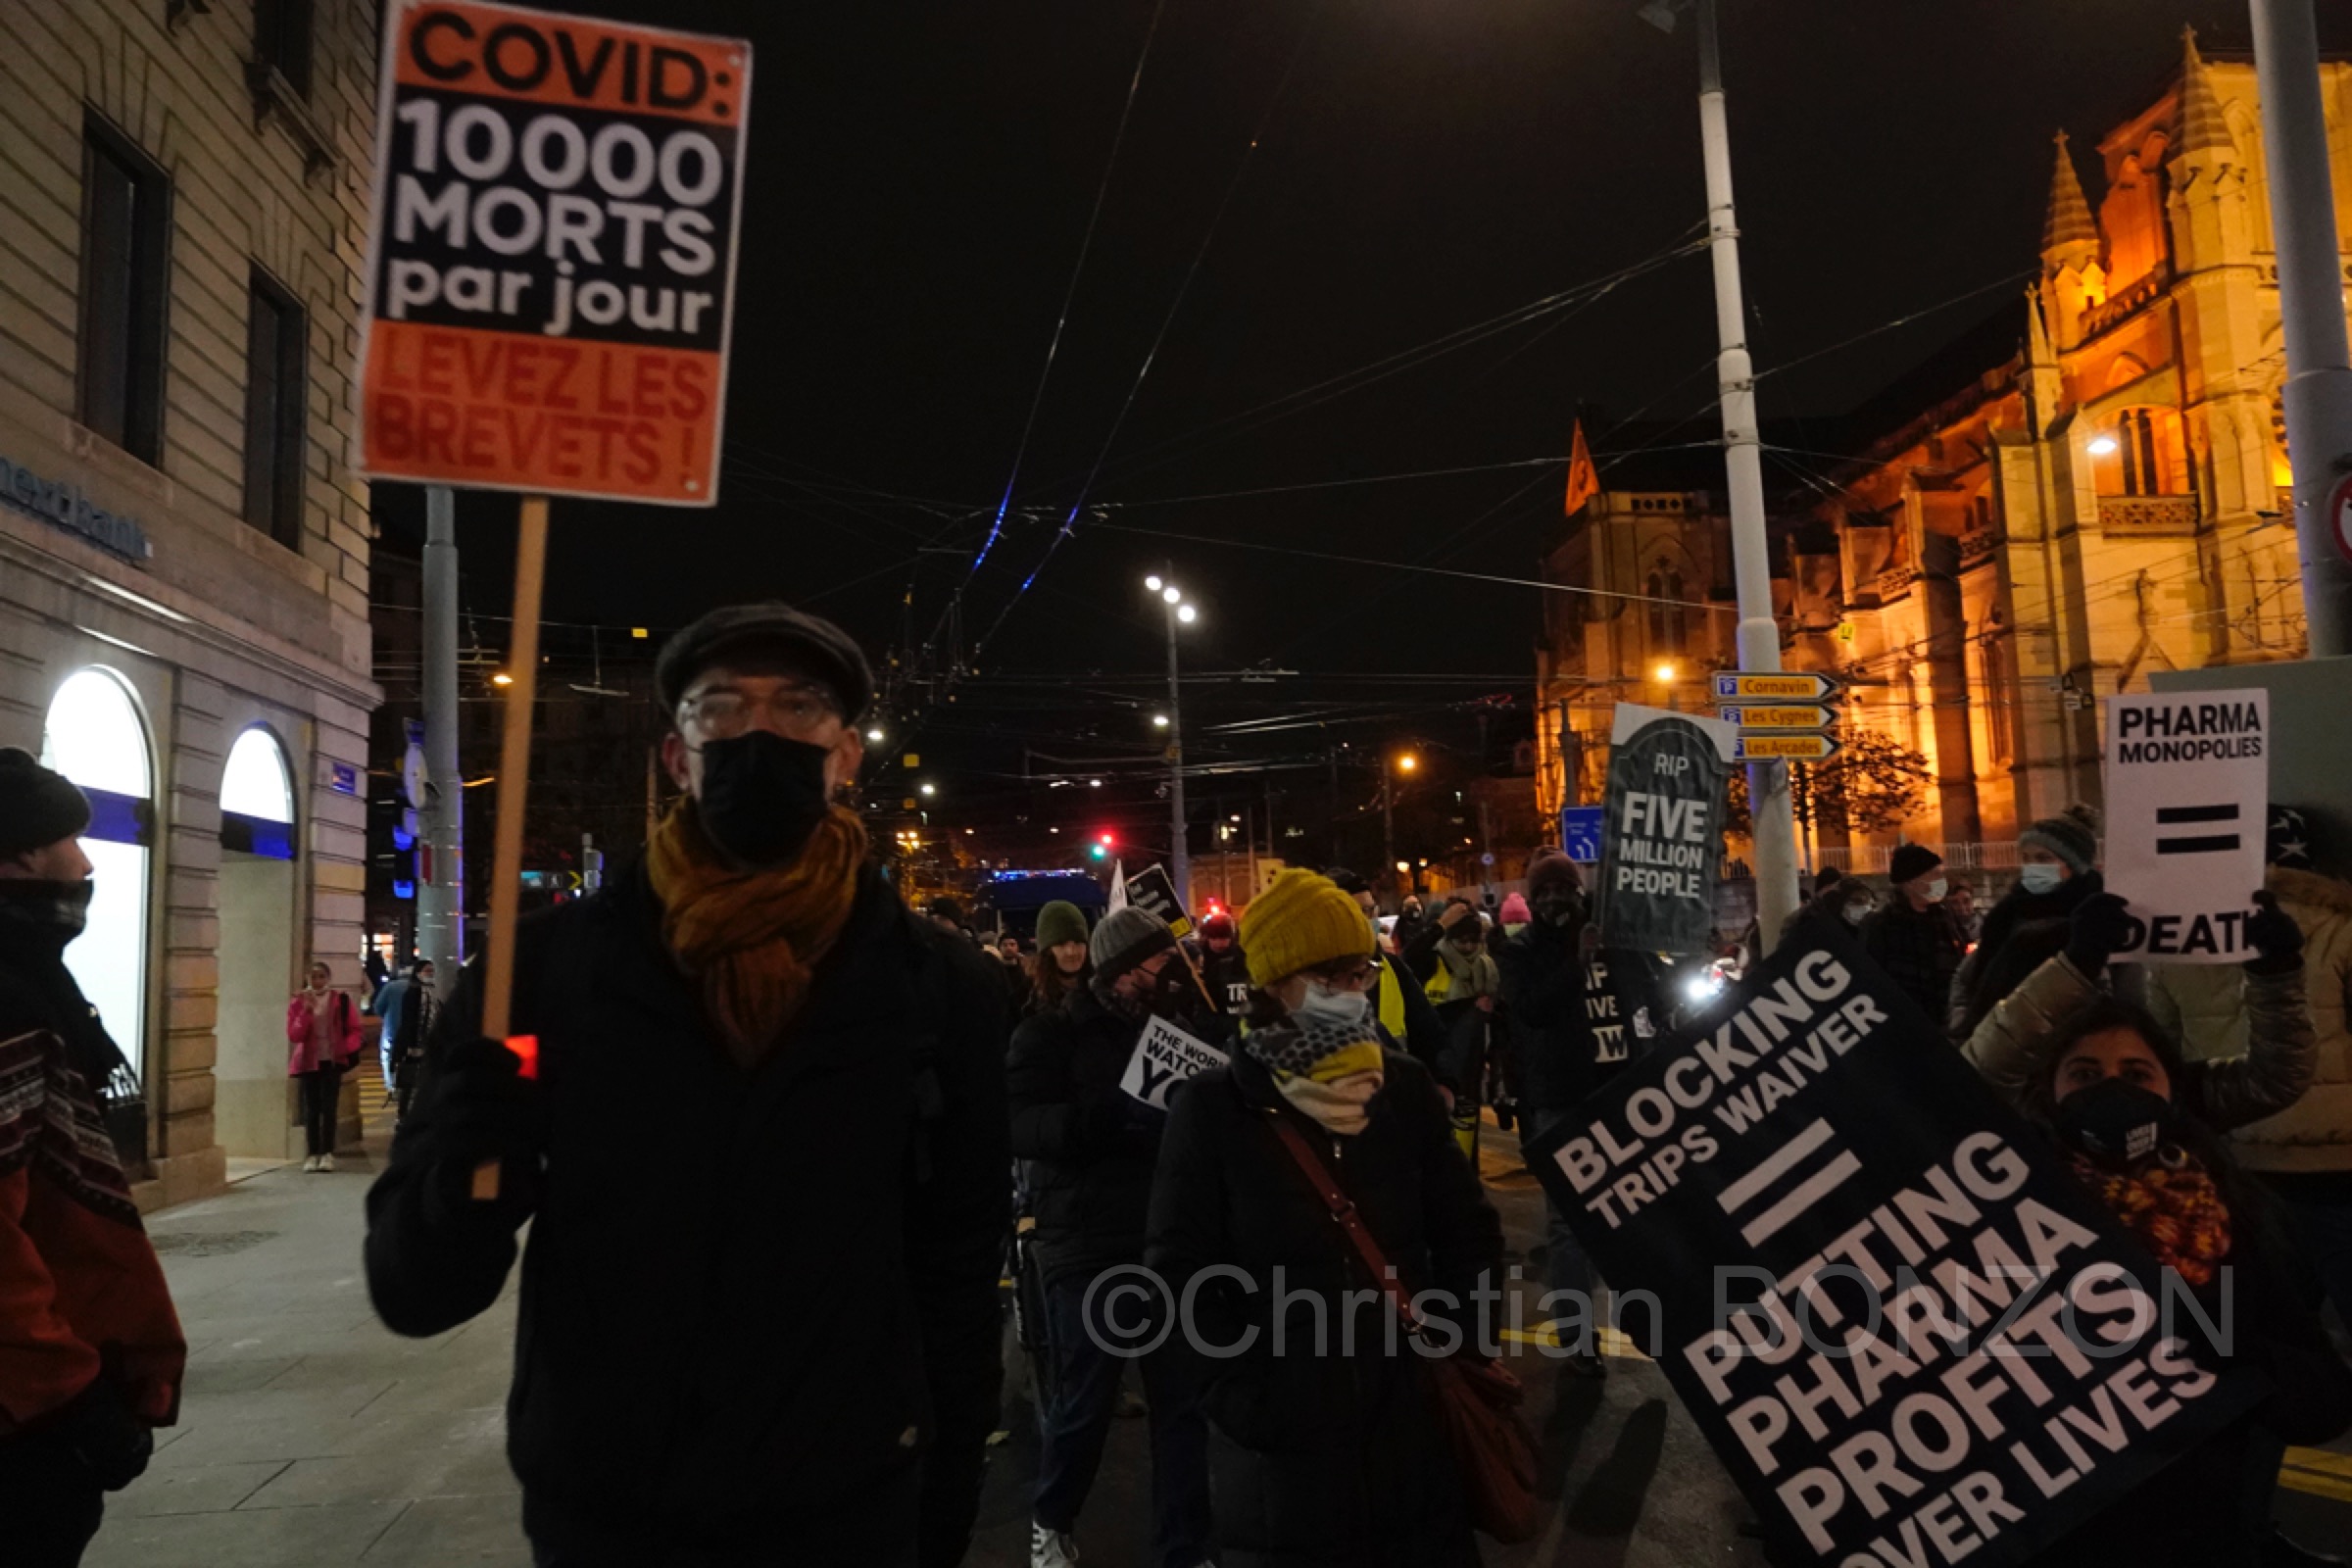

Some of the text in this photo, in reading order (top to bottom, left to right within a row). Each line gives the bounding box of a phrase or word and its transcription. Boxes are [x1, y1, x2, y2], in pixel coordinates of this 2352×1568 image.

[410, 11, 730, 118] COVID:
[394, 174, 715, 276] MORTS
[387, 258, 713, 336] par jour
[381, 329, 708, 423] LEVEZ LES
[1745, 679, 1810, 694] Cornavin
[1744, 709, 1765, 723] Les
[1769, 709, 1818, 726] Cygnes
[2119, 703, 2261, 737] PHARMA
[1654, 754, 1690, 777] RIP
[1746, 739, 1822, 755] Les Arcades
[2119, 737, 2261, 763] MONOPOLIES
[1622, 791, 1707, 843] FIVE
[1620, 838, 1704, 869] MILLION
[1617, 866, 1700, 899] PEOPLE
[1147, 1038, 1200, 1078] WATC
[1154, 1025, 1224, 1067] THE WOR
[1552, 950, 1852, 1196] BLOCKING
[1585, 993, 1889, 1230] TRIPS WAIVER
[1683, 1130, 2031, 1406] PUTTING
[1726, 1197, 2100, 1477] PHARMA
[1776, 1261, 2158, 1556] PROFITS
[1838, 1337, 2217, 1568] VER LIVES
